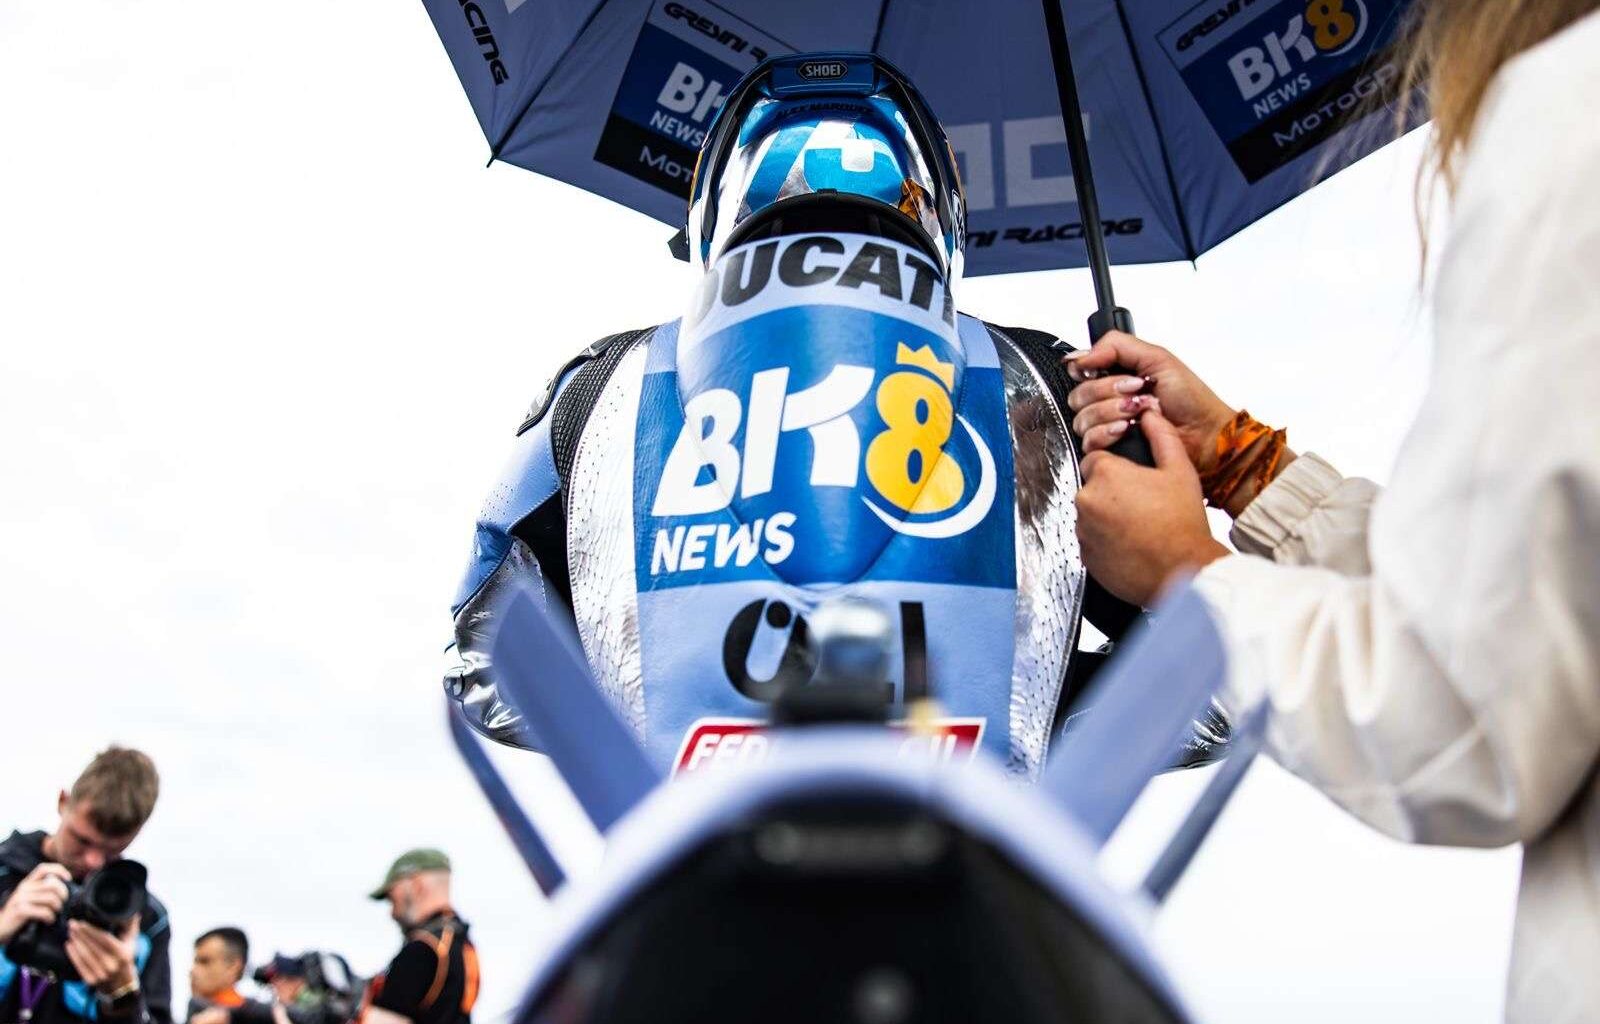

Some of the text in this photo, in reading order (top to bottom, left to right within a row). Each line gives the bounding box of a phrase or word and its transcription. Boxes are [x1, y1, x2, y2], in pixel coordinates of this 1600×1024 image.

[805, 64, 841, 77] SHOEI
[1227, 0, 1356, 101] BK8
[1253, 73, 1312, 119] NEWS
[649, 110, 705, 147] NEWS
[640, 145, 693, 183] MOT
[1002, 218, 1144, 244] RACNG
[651, 363, 966, 517] BK8
[651, 512, 796, 575] NEWS
